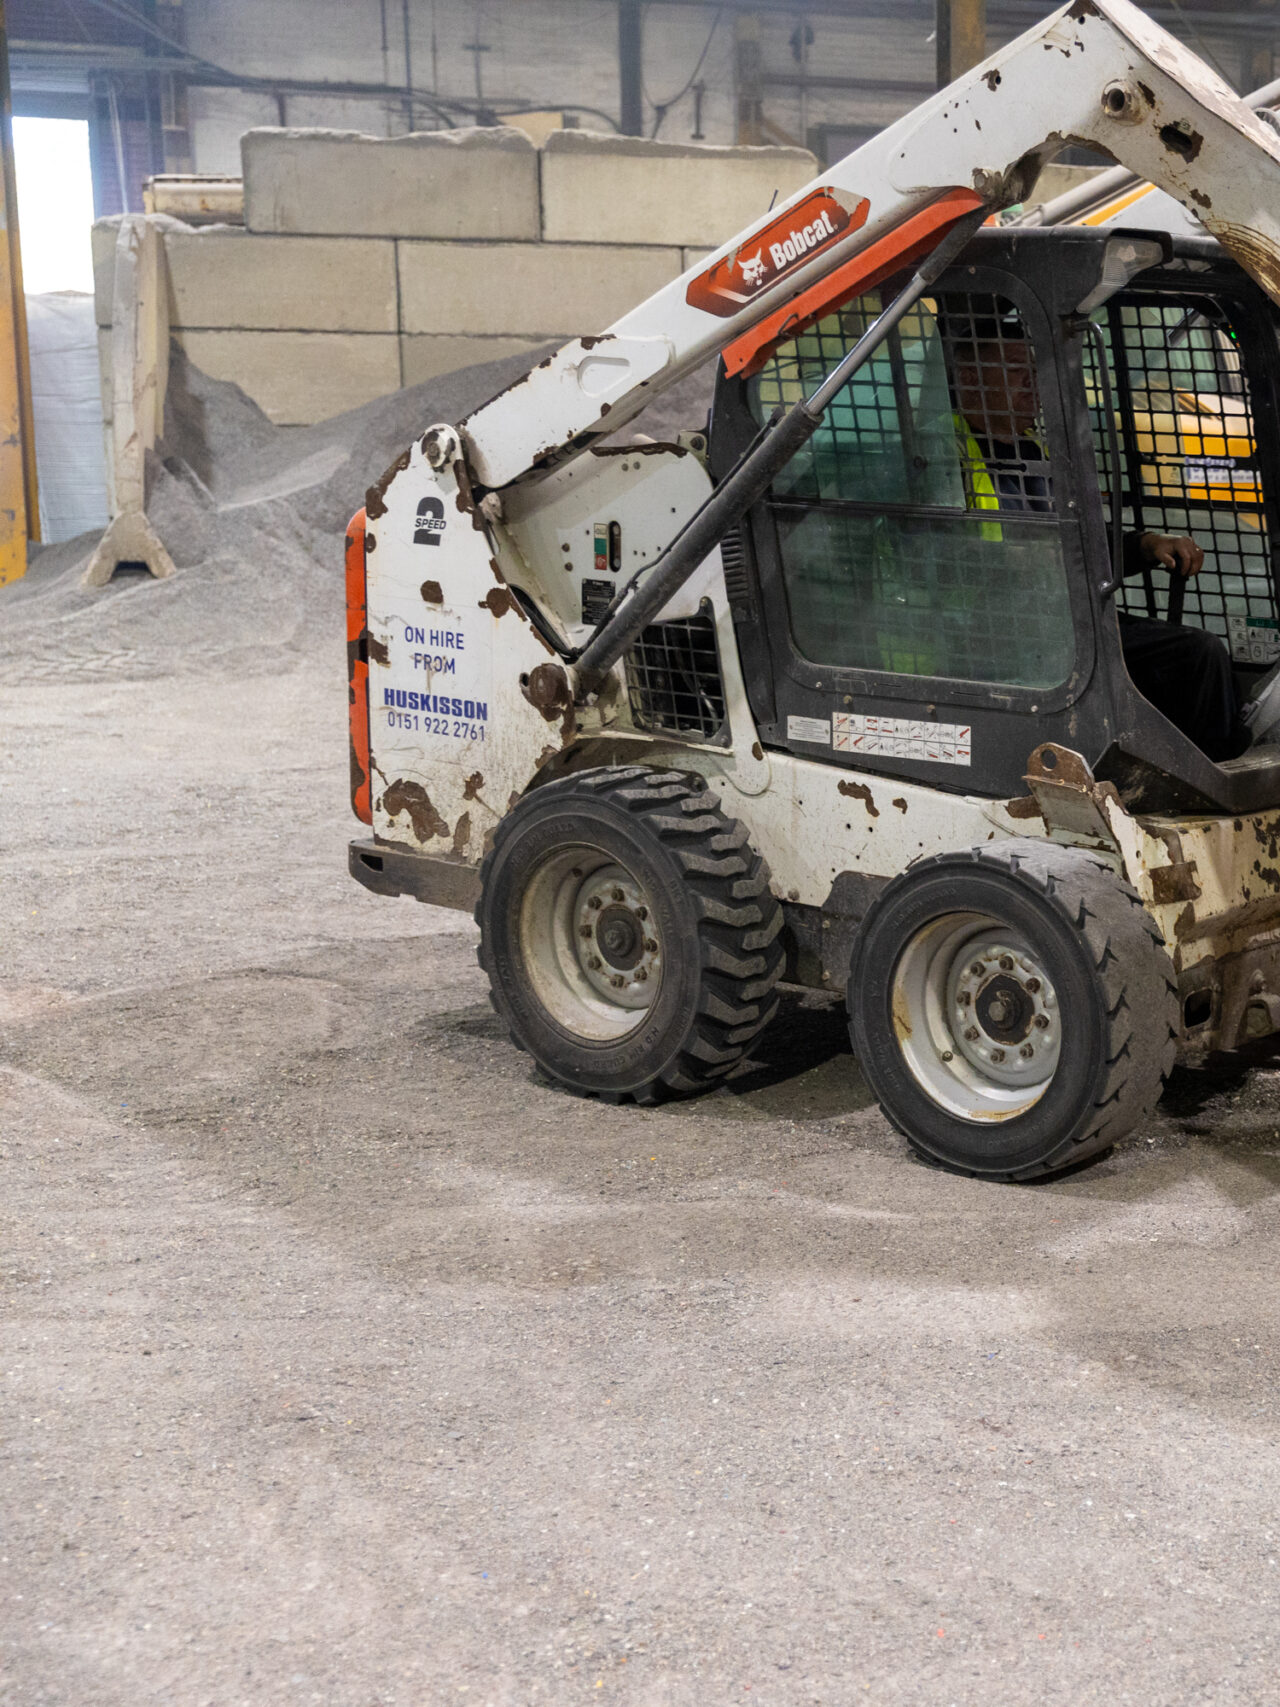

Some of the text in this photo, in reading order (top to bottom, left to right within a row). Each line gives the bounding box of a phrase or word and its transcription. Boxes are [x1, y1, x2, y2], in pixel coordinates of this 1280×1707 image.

[769, 210, 834, 270] Bobcat
[413, 497, 444, 546] 2
[415, 518, 447, 530] SPEED
[404, 626, 465, 650] ON HIRE
[414, 652, 456, 675] FROM
[384, 688, 488, 721] HUSKISSON
[388, 711, 485, 742] 0151 922 2761
